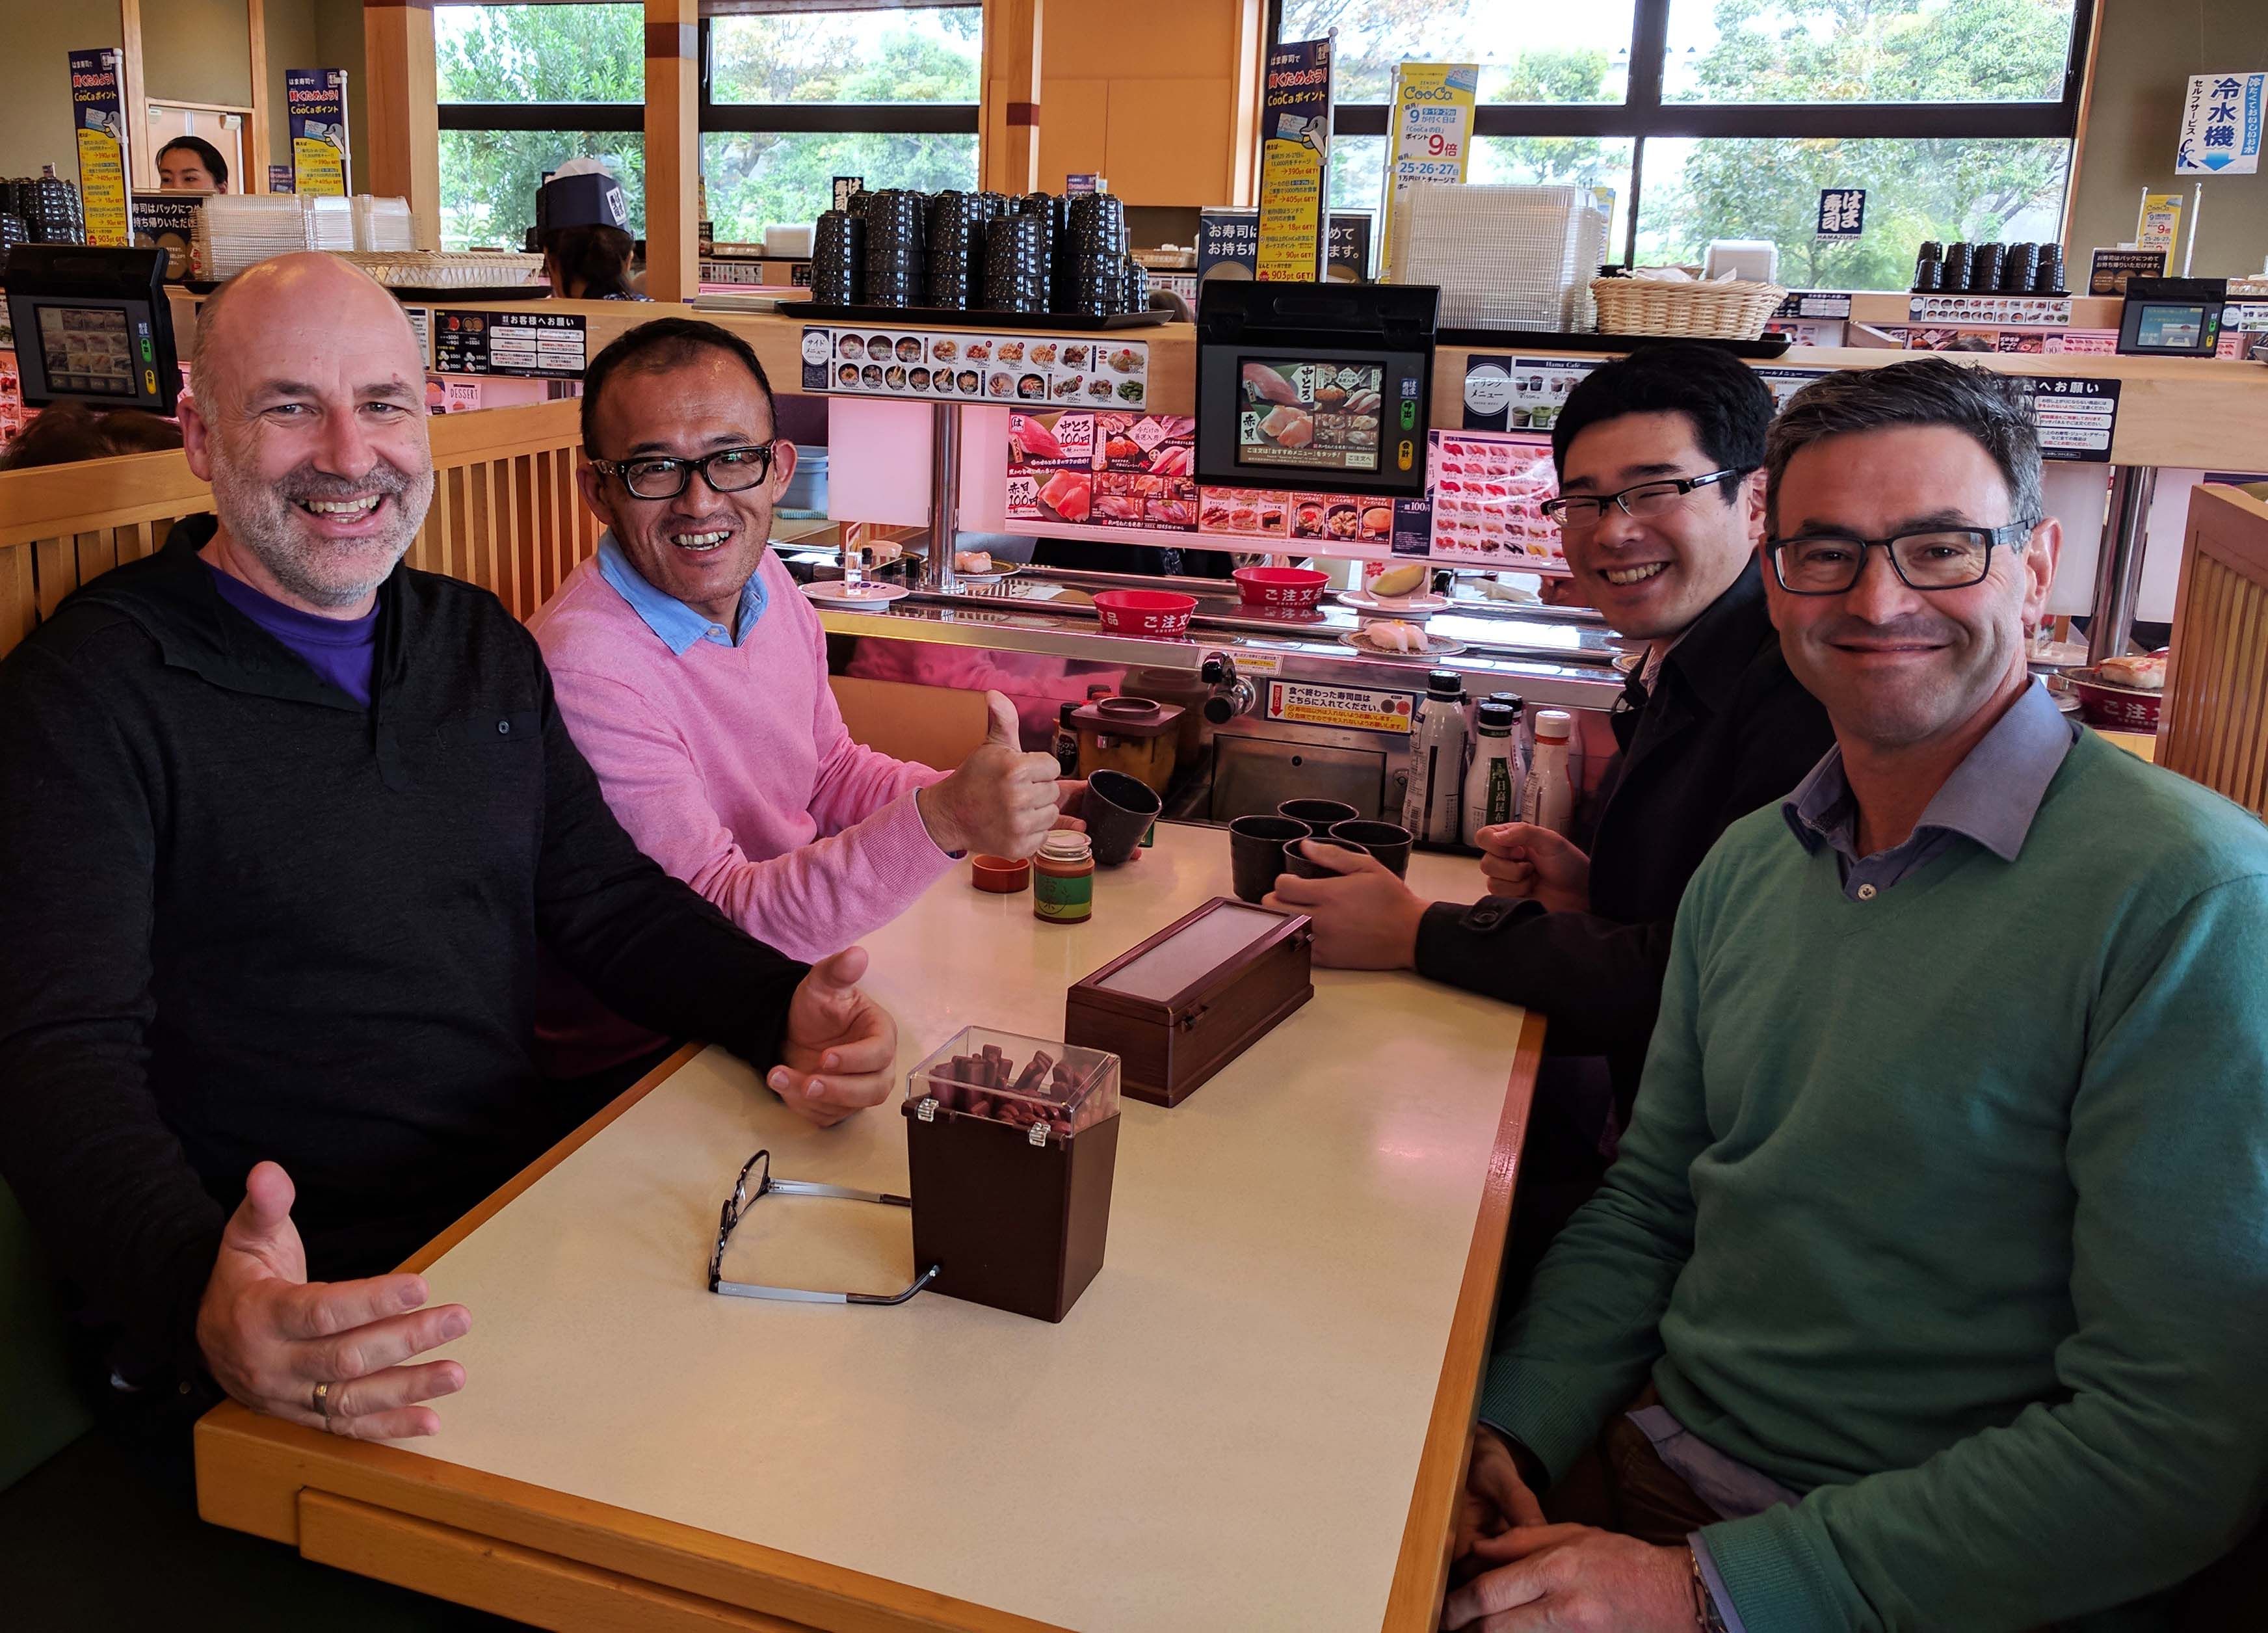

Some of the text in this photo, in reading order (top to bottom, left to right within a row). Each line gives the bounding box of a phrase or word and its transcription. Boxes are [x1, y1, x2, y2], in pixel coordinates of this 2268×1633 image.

[1404, 86, 1453, 101] CooCa
[2186, 79, 2204, 135] セルフサービス
[2204, 77, 2243, 147] 冷水機
[1410, 109, 1420, 123] 9
[2244, 77, 2261, 153] 冷たくておいしいお水
[1428, 134, 1444, 155] 9
[1445, 143, 1457, 156] 倍
[835, 178, 862, 211] は寿司
[1821, 191, 1863, 232] はま寿司
[2157, 224, 2165, 233] 9
[1272, 271, 1294, 280] 903pt
[510, 315, 575, 326] お客様へお願い
[1301, 367, 1314, 401] 中とろ
[2038, 381, 2100, 393] へお願い
[450, 388, 479, 400] DESSERT
[1471, 390, 1504, 398] メニュー
[1404, 403, 1412, 418] 呼出
[1060, 420, 1090, 433] 中とろ
[1243, 414, 1256, 440] 赤貝
[1060, 433, 1090, 445] 100円
[1402, 442, 1410, 458] 会計
[1009, 481, 1030, 495] 赤貝
[1009, 495, 1038, 507] 100円
[1144, 613, 1190, 629] ご注文
[1288, 686, 1371, 702] 食べ終わった寿司皿は
[1287, 696, 1380, 713] こちらに入れてください。
